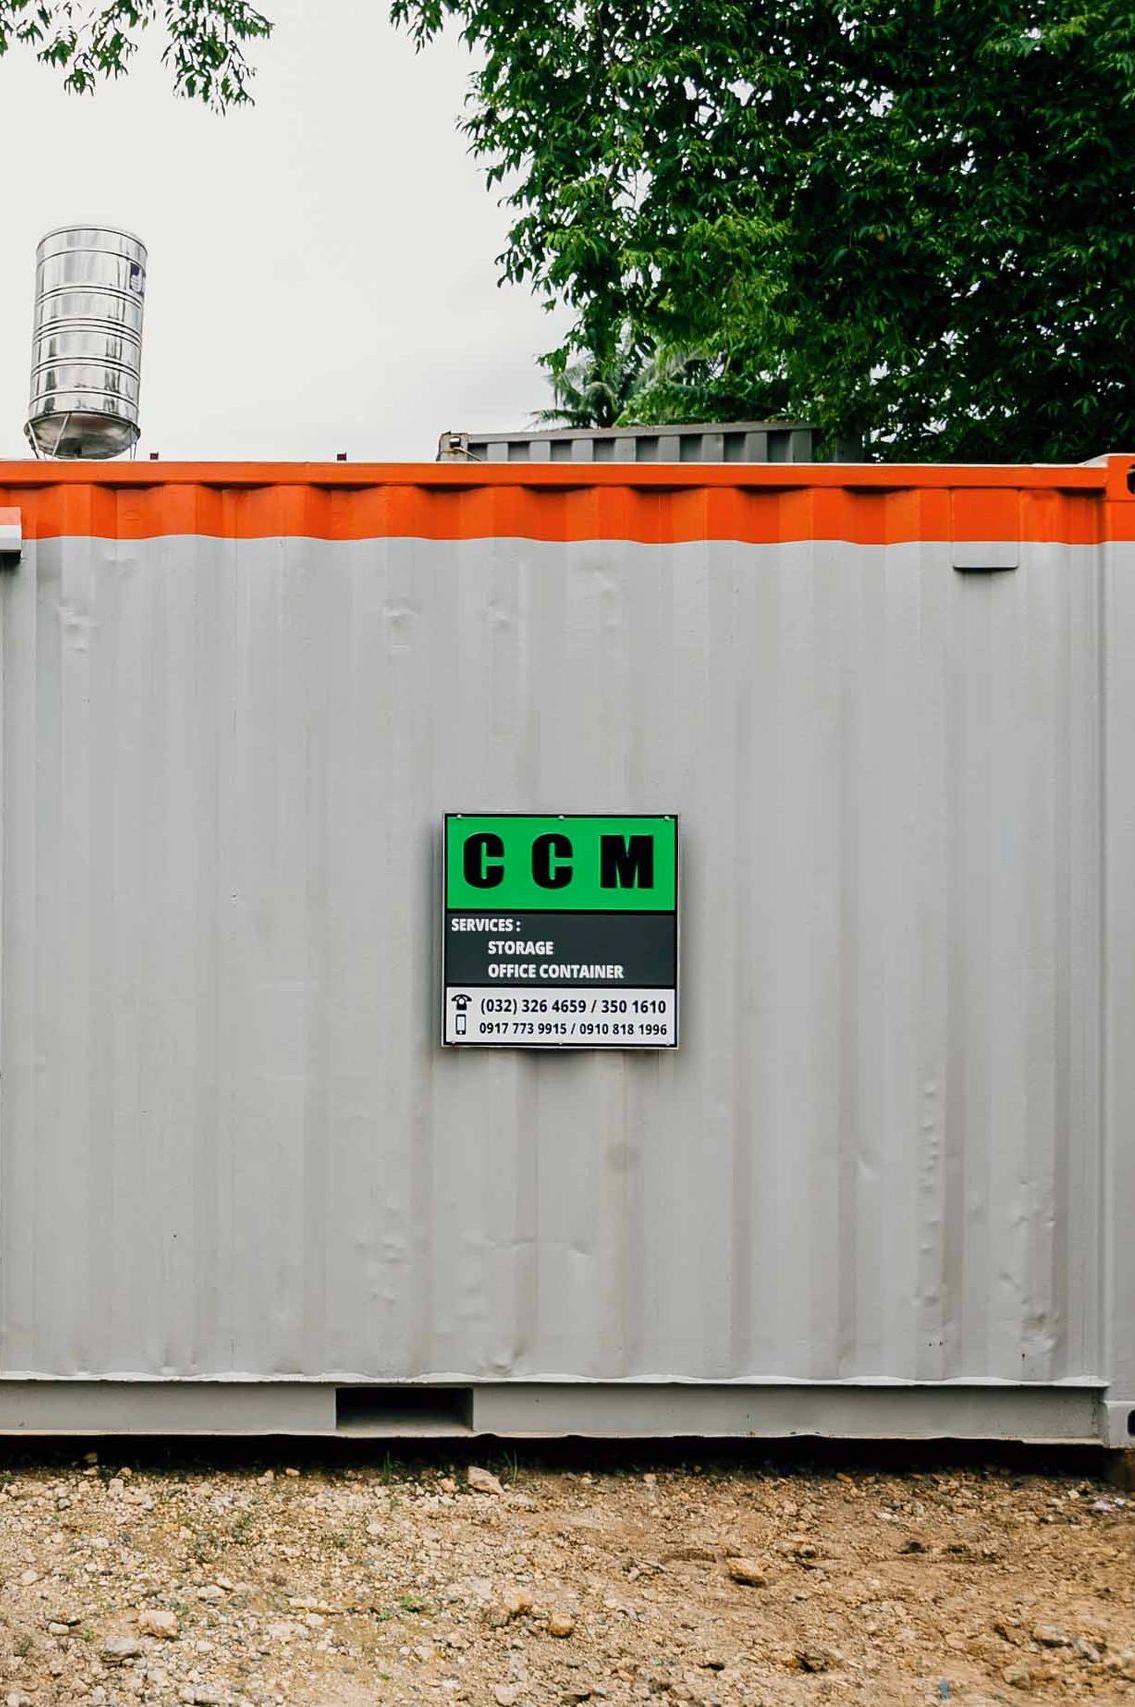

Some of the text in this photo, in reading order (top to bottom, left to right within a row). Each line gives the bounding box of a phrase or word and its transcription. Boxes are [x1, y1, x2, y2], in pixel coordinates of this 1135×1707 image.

[488, 941, 554, 955] STORAGE
[488, 964, 625, 979] OFFICE CONTAINER
[480, 998, 518, 1015] (032)
[521, 999, 548, 1013] 326
[551, 1000, 587, 1013] 4659
[601, 1000, 628, 1014] 350
[631, 1000, 667, 1014] 1610
[479, 1022, 509, 1035] 0917
[512, 1022, 534, 1035] 773
[537, 1023, 567, 1035] 9915
[579, 1023, 609, 1036] 0910
[612, 1023, 635, 1036] 818
[638, 1023, 667, 1036] 1996
